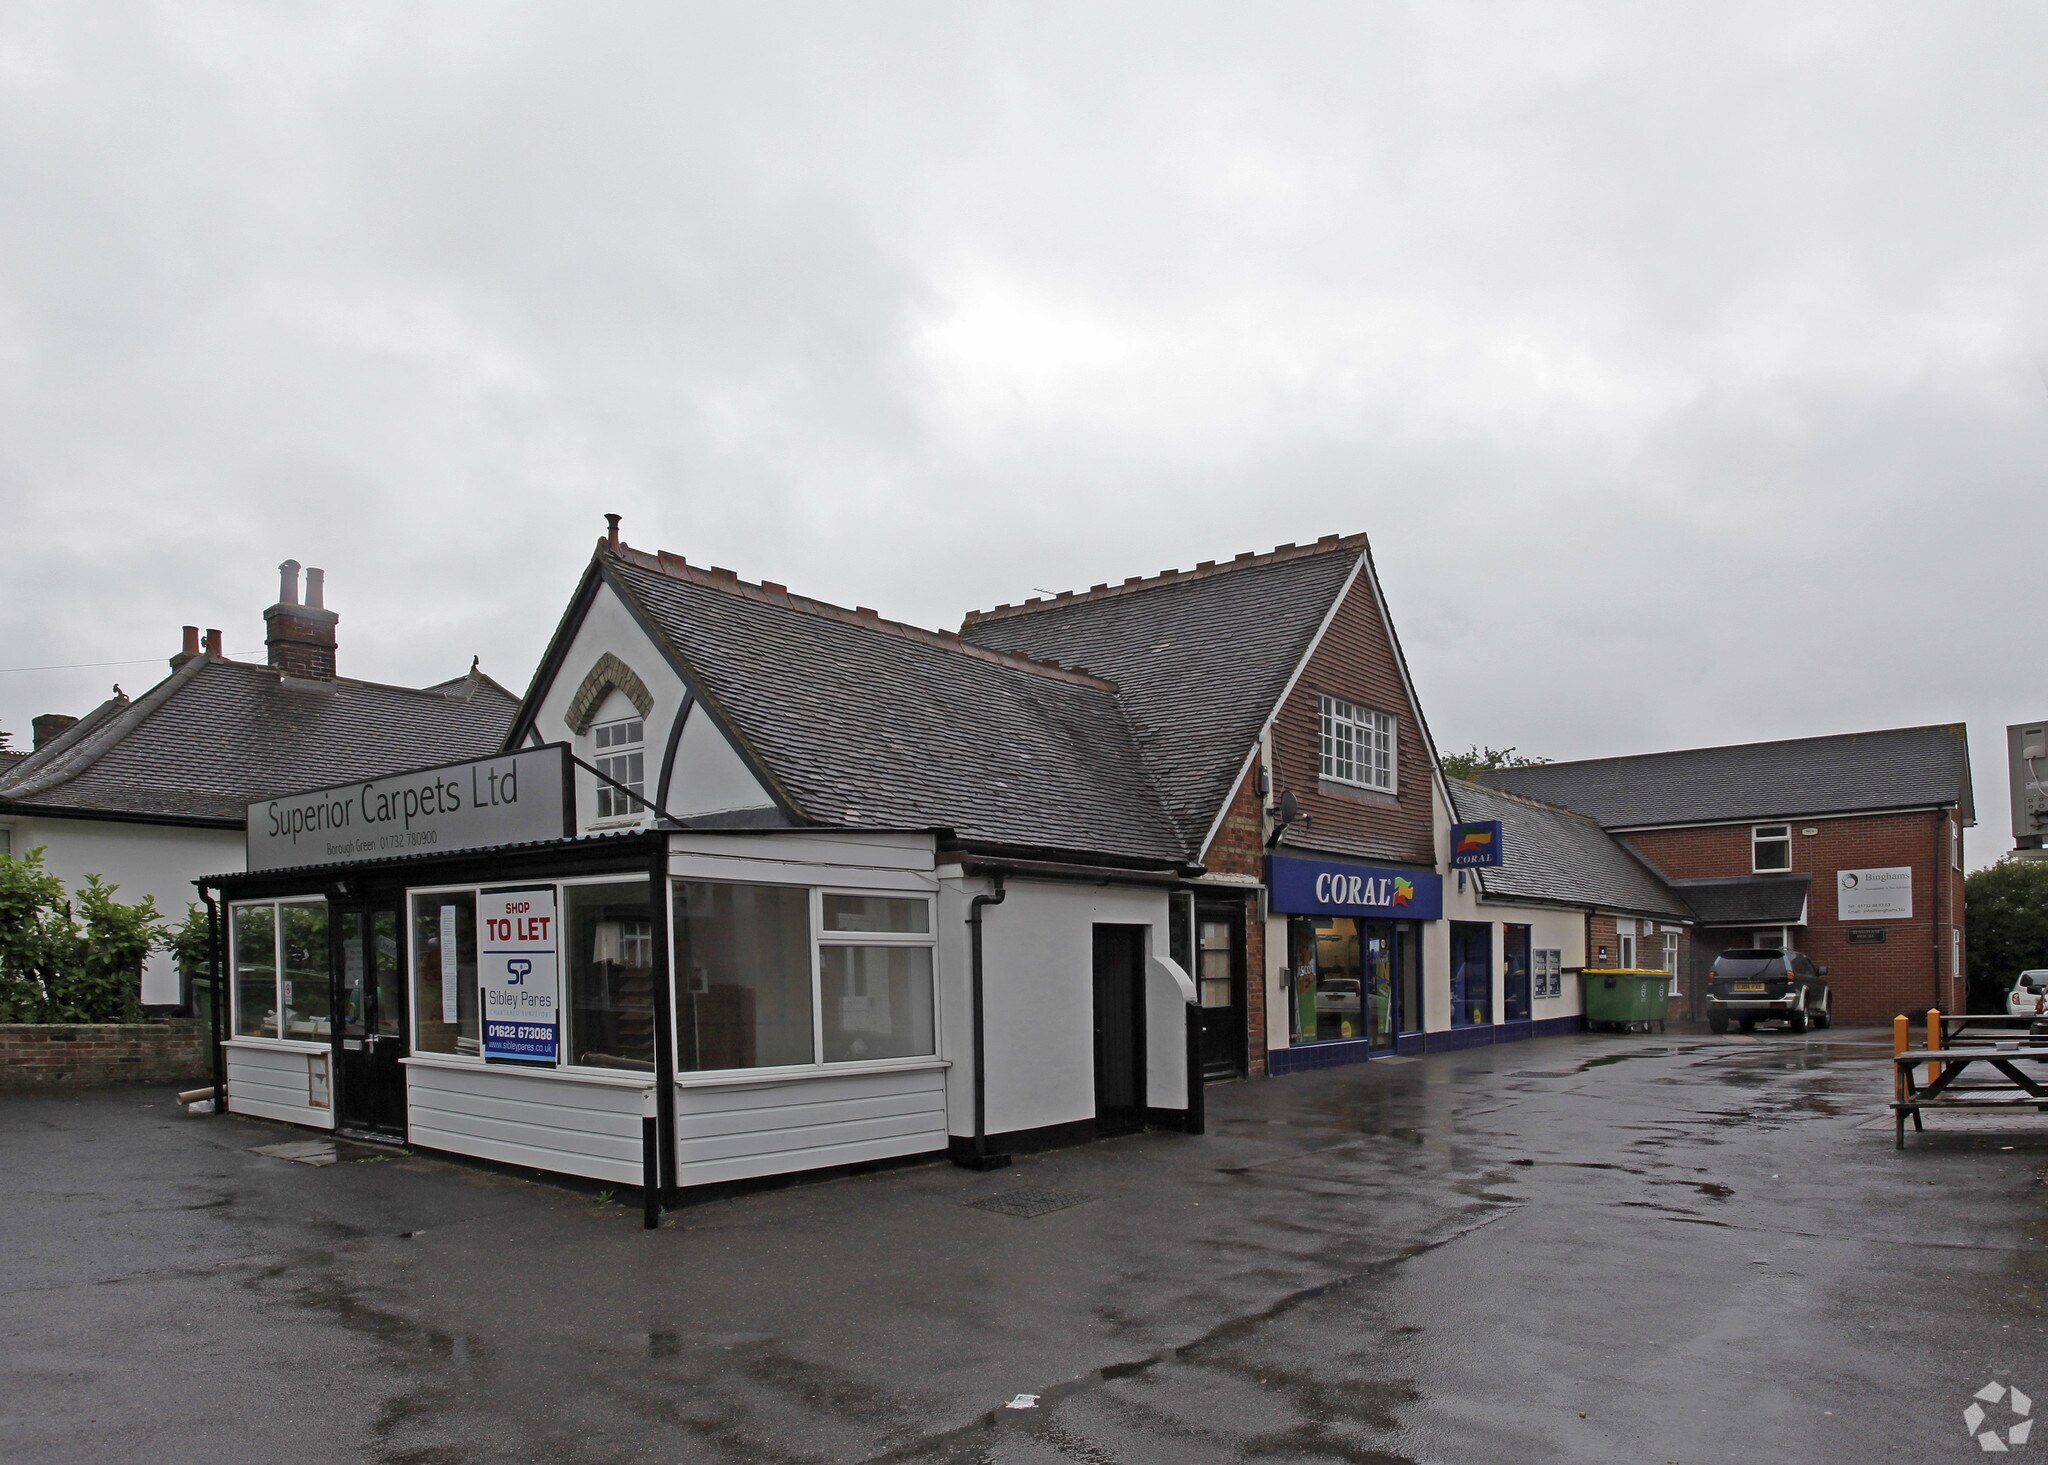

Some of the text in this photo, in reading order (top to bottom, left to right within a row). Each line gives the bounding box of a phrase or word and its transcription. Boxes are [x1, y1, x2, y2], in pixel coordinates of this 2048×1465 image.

[269, 758, 518, 845] Superior Carpets Ltd
[327, 830, 437, 857] Borough Green 01732 780900
[1456, 853, 1493, 865] CORAL
[1865, 872, 1910, 883] Binghams
[1315, 873, 1391, 907] CORAL
[505, 902, 530, 914] SHOP
[486, 917, 550, 941] TO LET
[489, 990, 552, 1009] Sibley Pares
[489, 1008, 552, 1018] CHARTERED SURVEYORS
[489, 1024, 552, 1041] 01622 673086
[489, 1040, 552, 1053] www.sibleypares.co.uk
